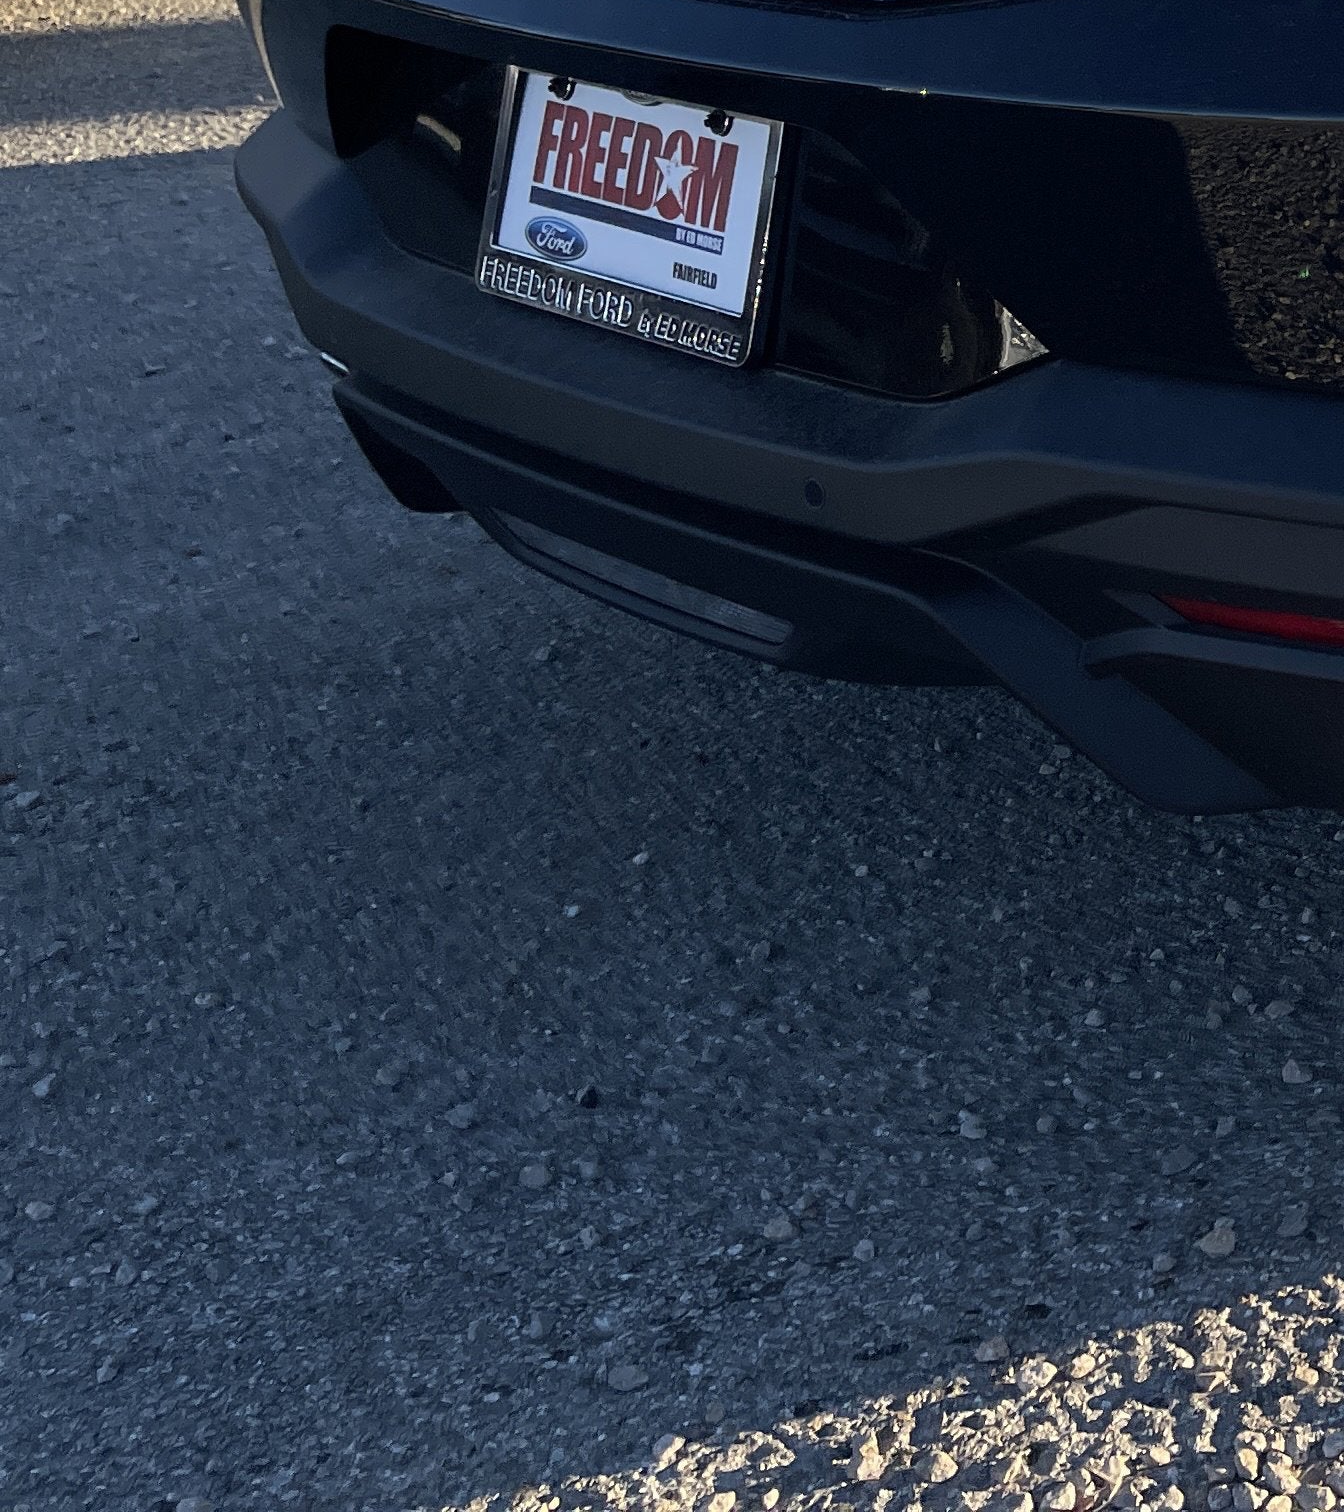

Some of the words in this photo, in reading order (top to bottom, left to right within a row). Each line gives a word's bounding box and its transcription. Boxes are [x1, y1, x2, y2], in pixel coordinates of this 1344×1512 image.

[533, 99, 739, 233] FREEDOM
[536, 221, 576, 255] Ford
[480, 255, 573, 312] FREEDOM
[576, 283, 634, 328] FORD
[655, 311, 680, 342] ED
[679, 320, 742, 361] MORSE
[673, 262, 717, 289] FAIRFIELD
